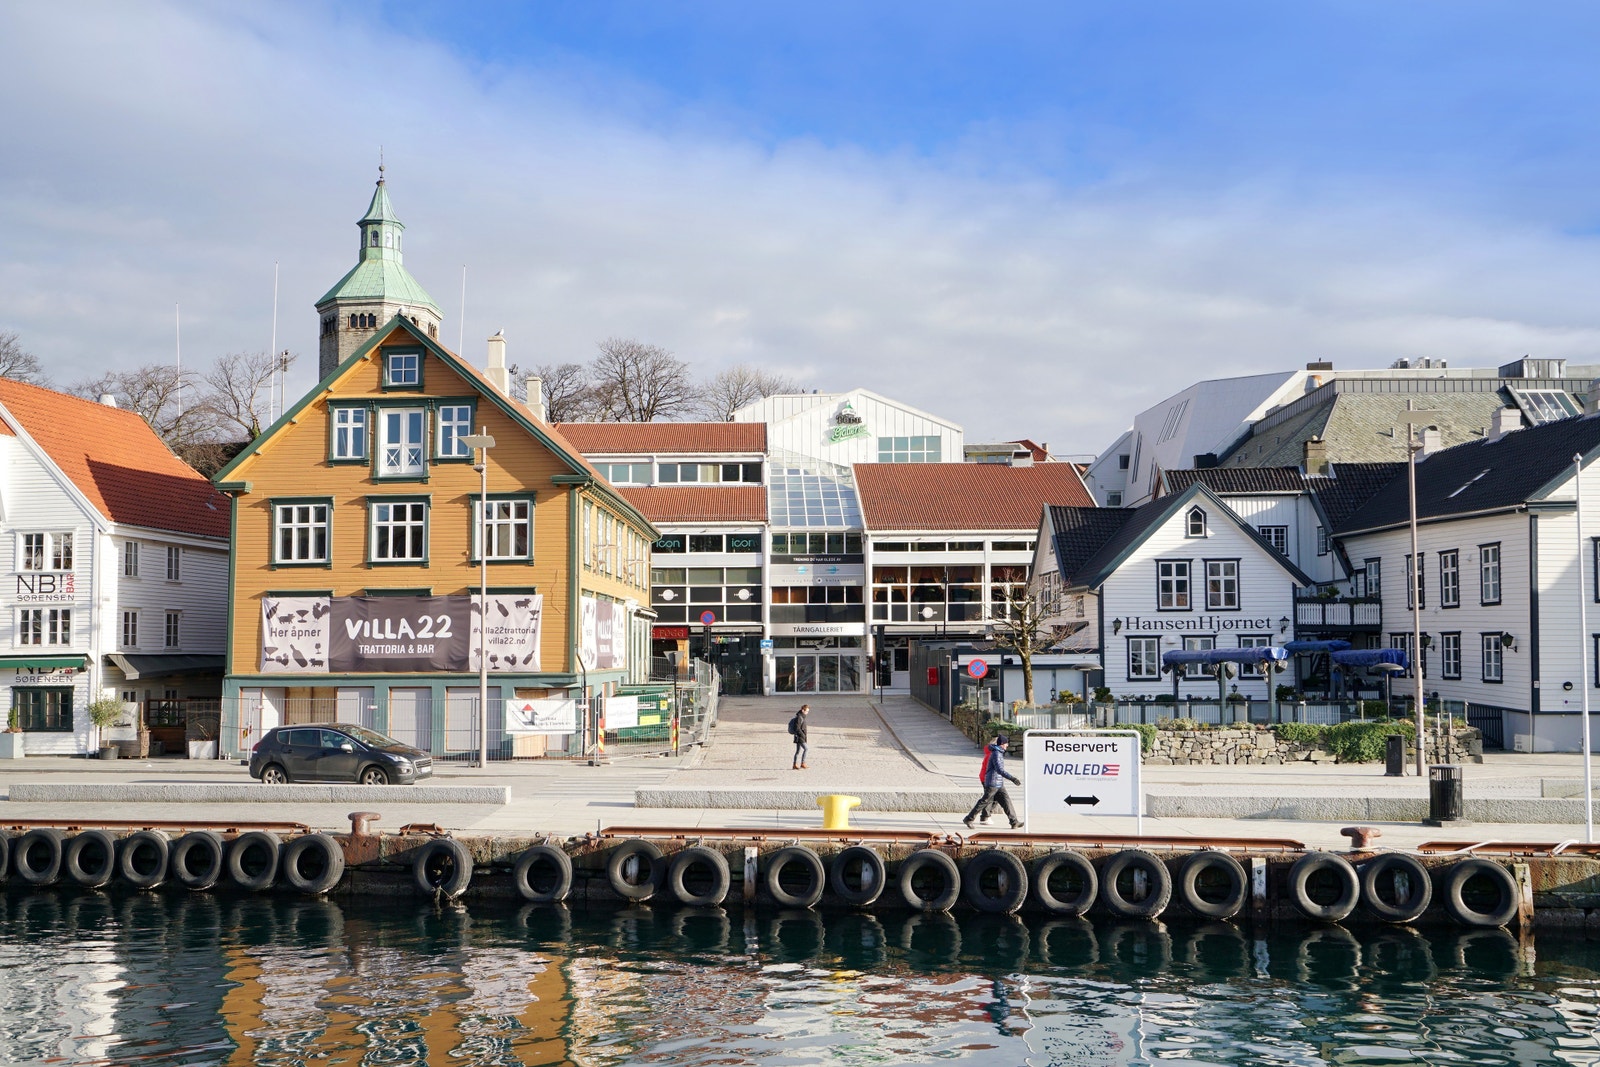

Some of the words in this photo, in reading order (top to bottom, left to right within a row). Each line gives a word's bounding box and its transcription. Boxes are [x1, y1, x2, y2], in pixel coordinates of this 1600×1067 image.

[17, 574, 63, 594] NB!
[66, 573, 75, 593] BAR
[270, 627, 289, 637] Her
[291, 625, 321, 640] åpner
[473, 626, 536, 634] #vlla22trattoria
[488, 637, 526, 645] villa22.no
[359, 644, 406, 654] TRATTORIA
[408, 644, 415, 654] &
[417, 644, 435, 654] BAR
[1045, 740, 1118, 752] Reservert
[1043, 763, 1100, 775] NORLED
